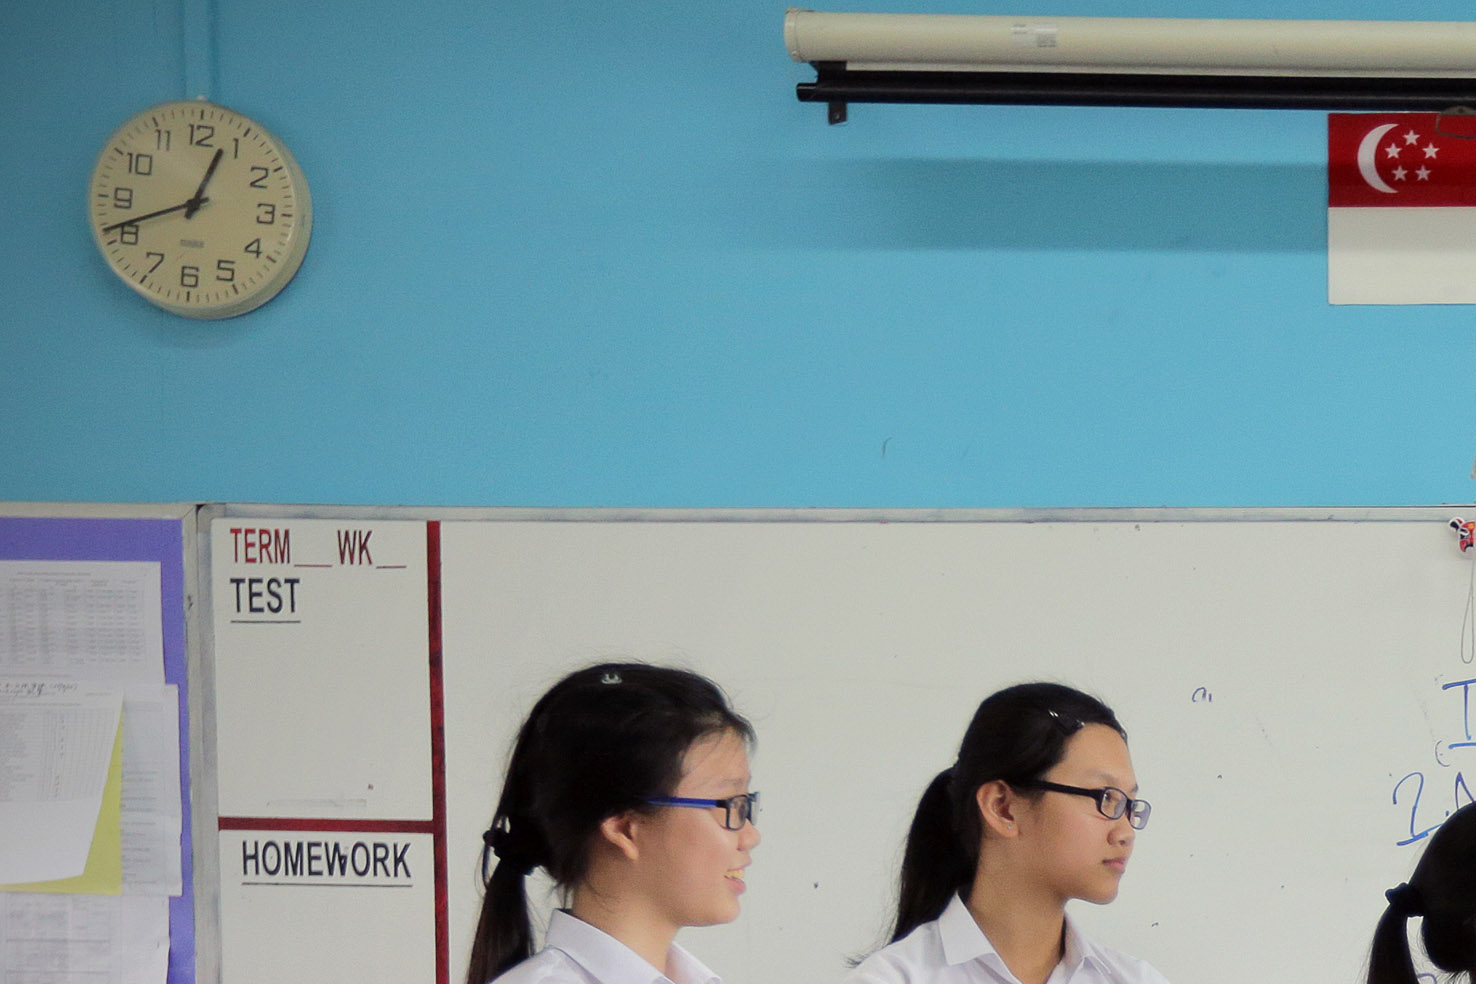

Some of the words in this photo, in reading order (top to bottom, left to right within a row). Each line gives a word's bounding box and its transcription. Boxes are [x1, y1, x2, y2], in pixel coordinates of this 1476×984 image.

[155, 129, 171, 151] 11
[188, 124, 215, 148] 12
[233, 138, 240, 160] 1
[127, 152, 153, 176] 10
[249, 166, 269, 189] 2
[114, 187, 133, 209] 9
[257, 203, 276, 225] 3
[120, 222, 139, 245] 8
[244, 238, 262, 259] 4
[146, 251, 165, 274] 7
[216, 259, 236, 282] 5
[180, 265, 200, 288] 6
[230, 528, 290, 564] TERM
[337, 529, 373, 566] WK
[230, 578, 300, 613] TEST
[242, 840, 412, 879] HOMEWORK
